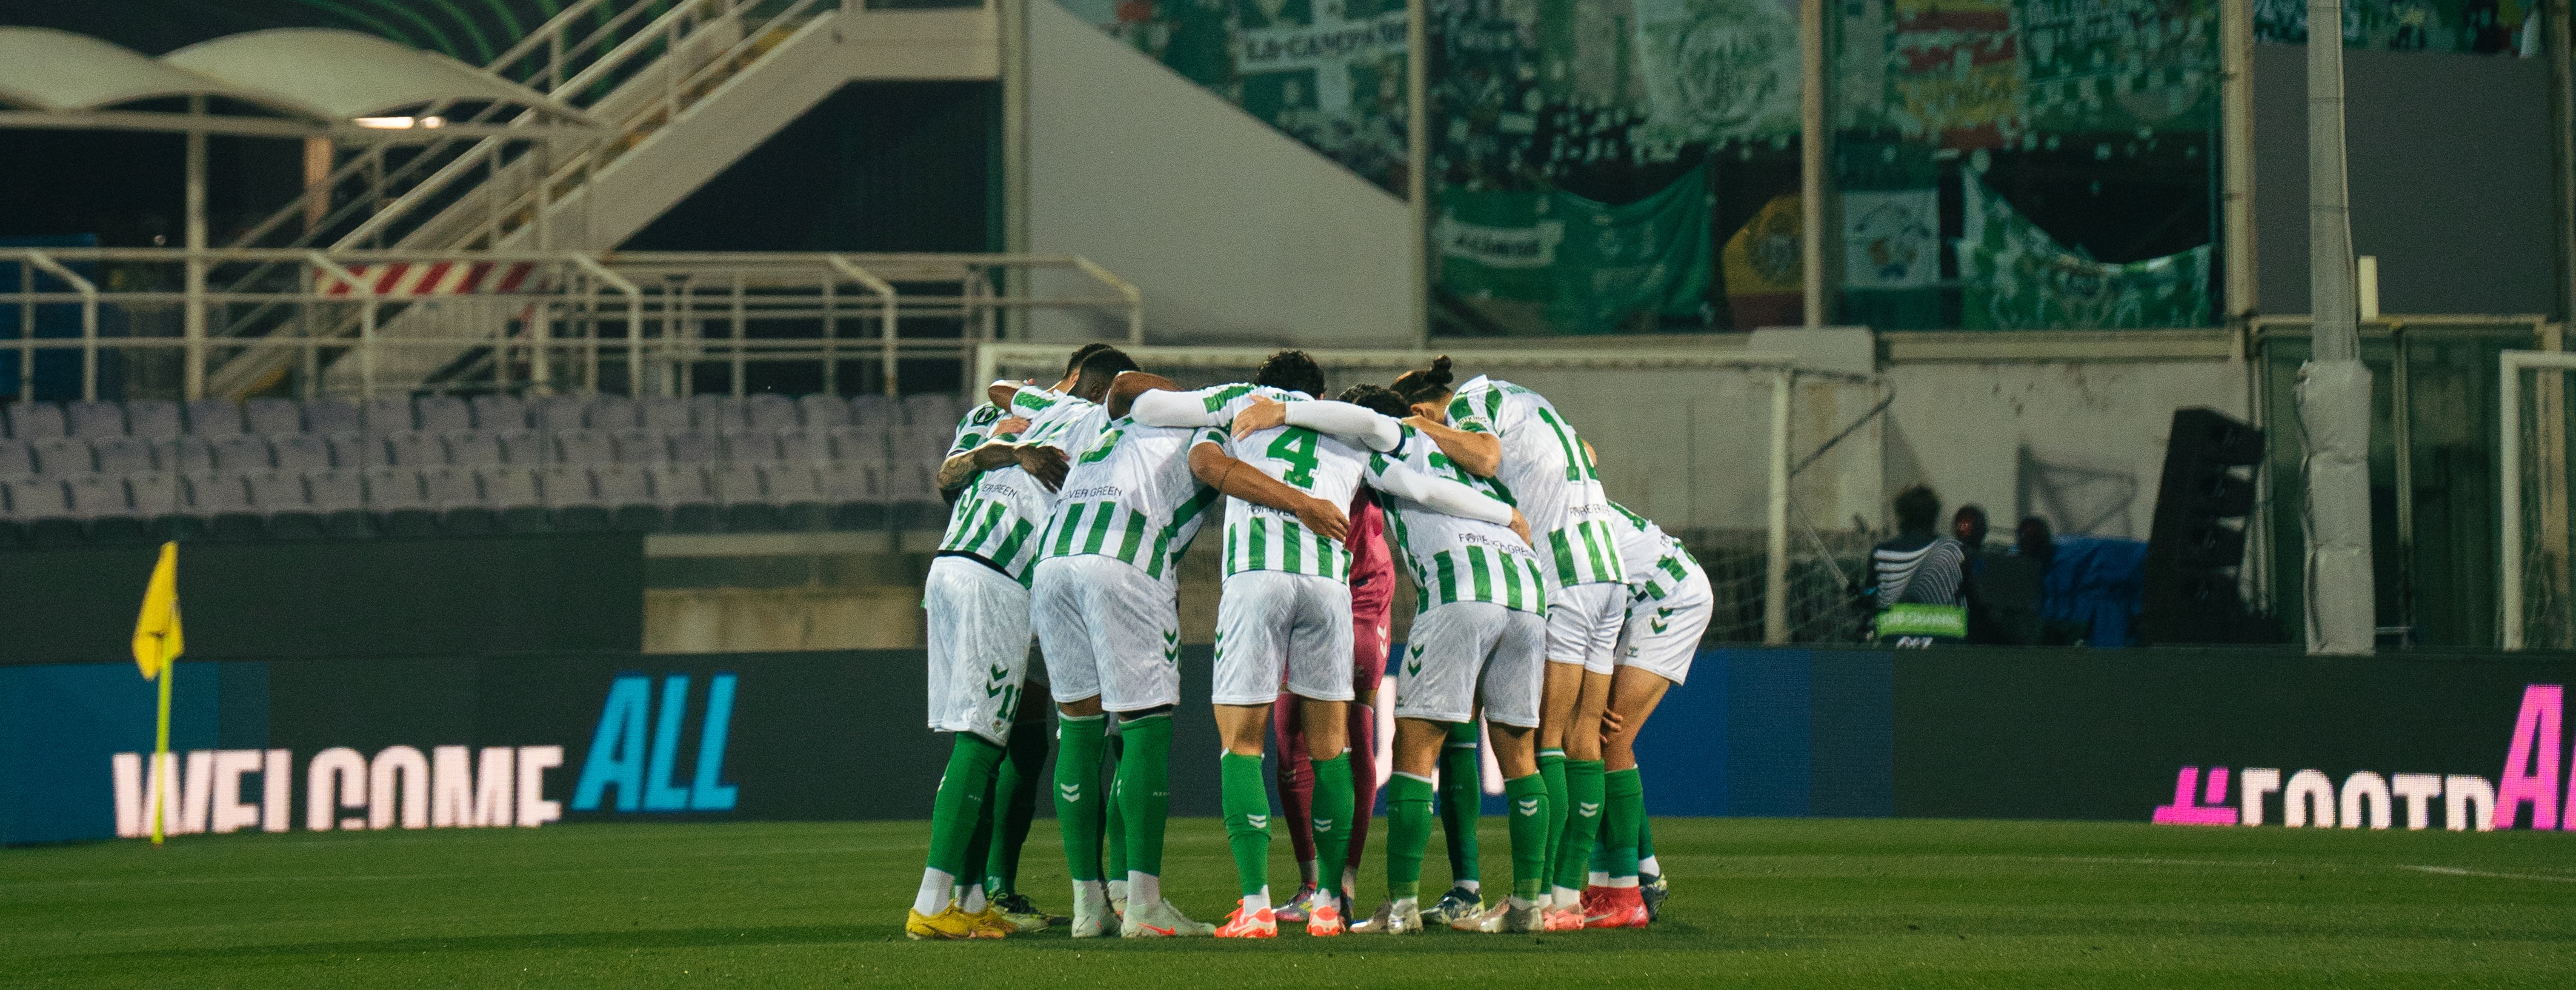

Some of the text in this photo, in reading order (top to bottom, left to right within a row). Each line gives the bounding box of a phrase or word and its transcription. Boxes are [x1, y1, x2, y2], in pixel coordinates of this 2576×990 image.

[1266, 425, 1321, 493] 4
[1090, 486, 1123, 498] GREEN
[996, 684, 1022, 722] 11
[571, 672, 739, 813] ALL
